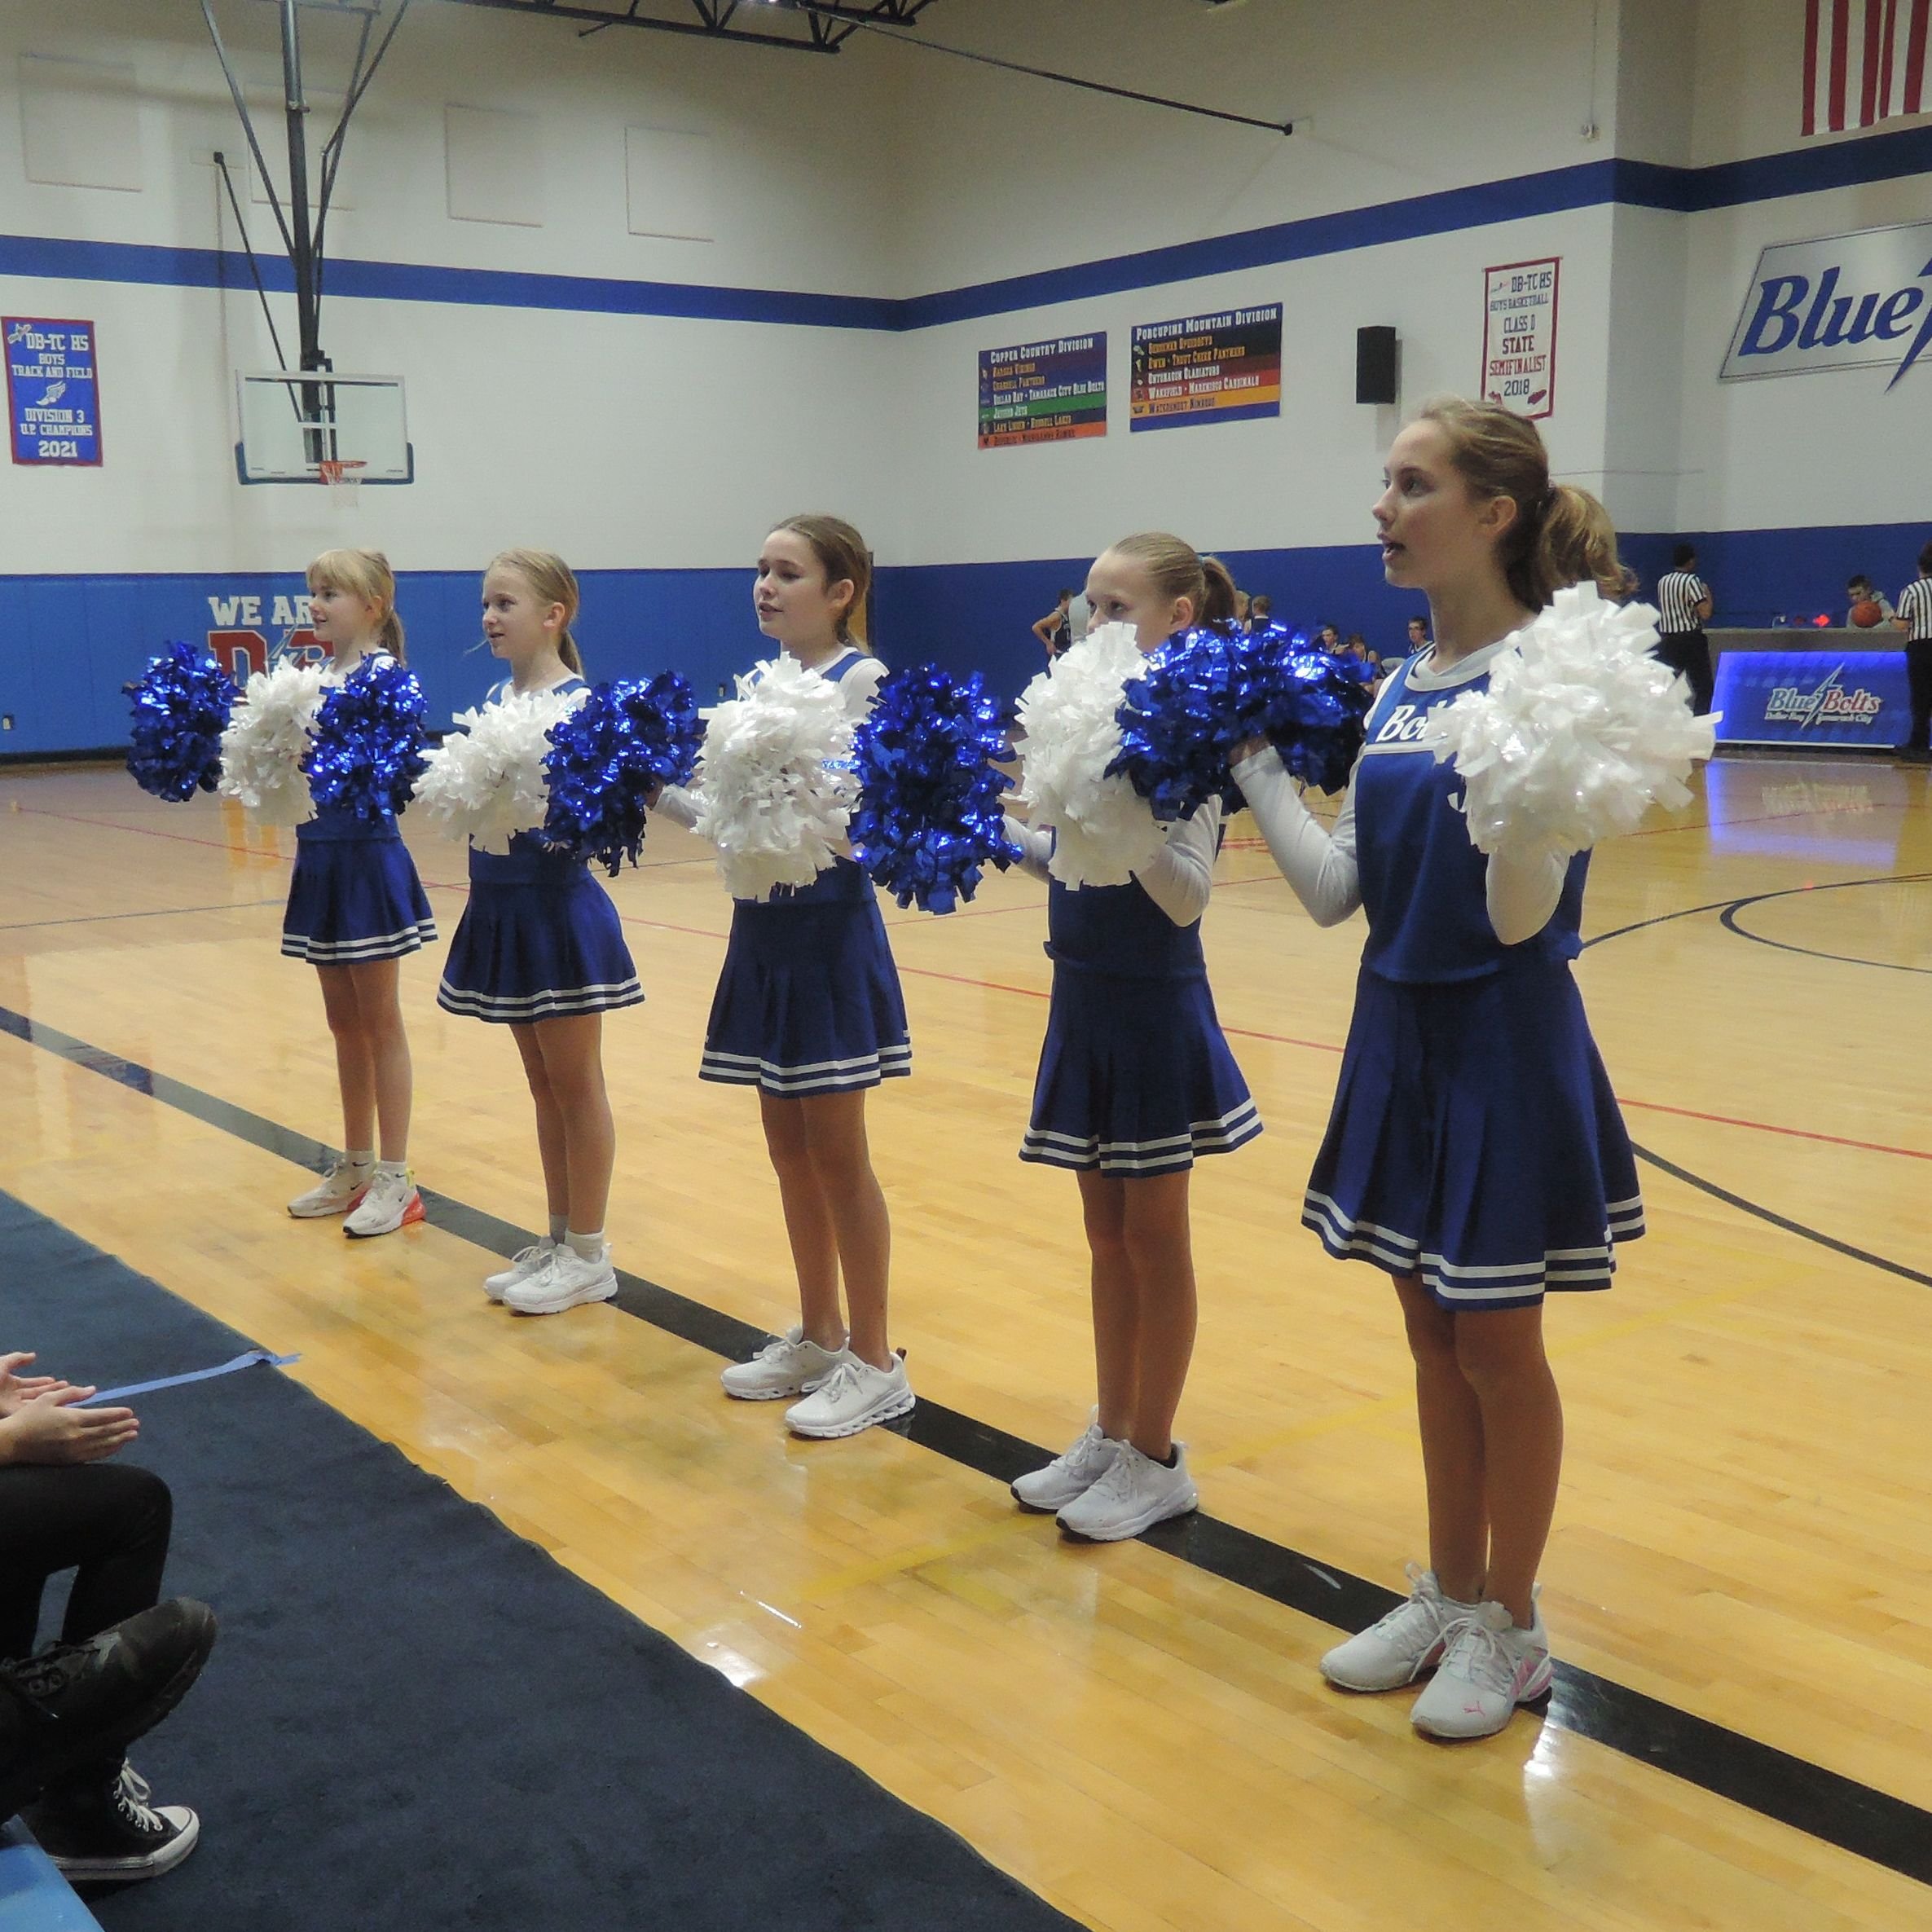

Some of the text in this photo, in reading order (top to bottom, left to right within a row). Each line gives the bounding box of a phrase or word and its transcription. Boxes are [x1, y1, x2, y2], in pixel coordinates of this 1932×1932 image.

[1511, 271, 1551, 293] DB-TC HS
[1490, 293, 1548, 312] BOYS BASKETBALL
[1737, 266, 1924, 356] Blue
[1136, 307, 1277, 341] PORCUPINE MOUNTAIN DIVISION
[1503, 315, 1528, 334] CLASS
[25, 332, 89, 351] DB-TC HS
[991, 337, 1094, 364] COPPER COUNTRY DIVISION
[1502, 335, 1534, 355] STATE
[39, 353, 65, 365] BOYS
[1490, 354, 1547, 376] SEMIFINALIST
[11, 364, 92, 379] TRACK AND FIELD
[1503, 378, 1529, 397] 2018
[24, 407, 85, 424] DIVISION 3
[40, 424, 93, 436] CHAMPIONS
[38, 440, 77, 458] 2021
[208, 596, 314, 626] WE AR
[1767, 688, 1882, 714] Blue Bolts
